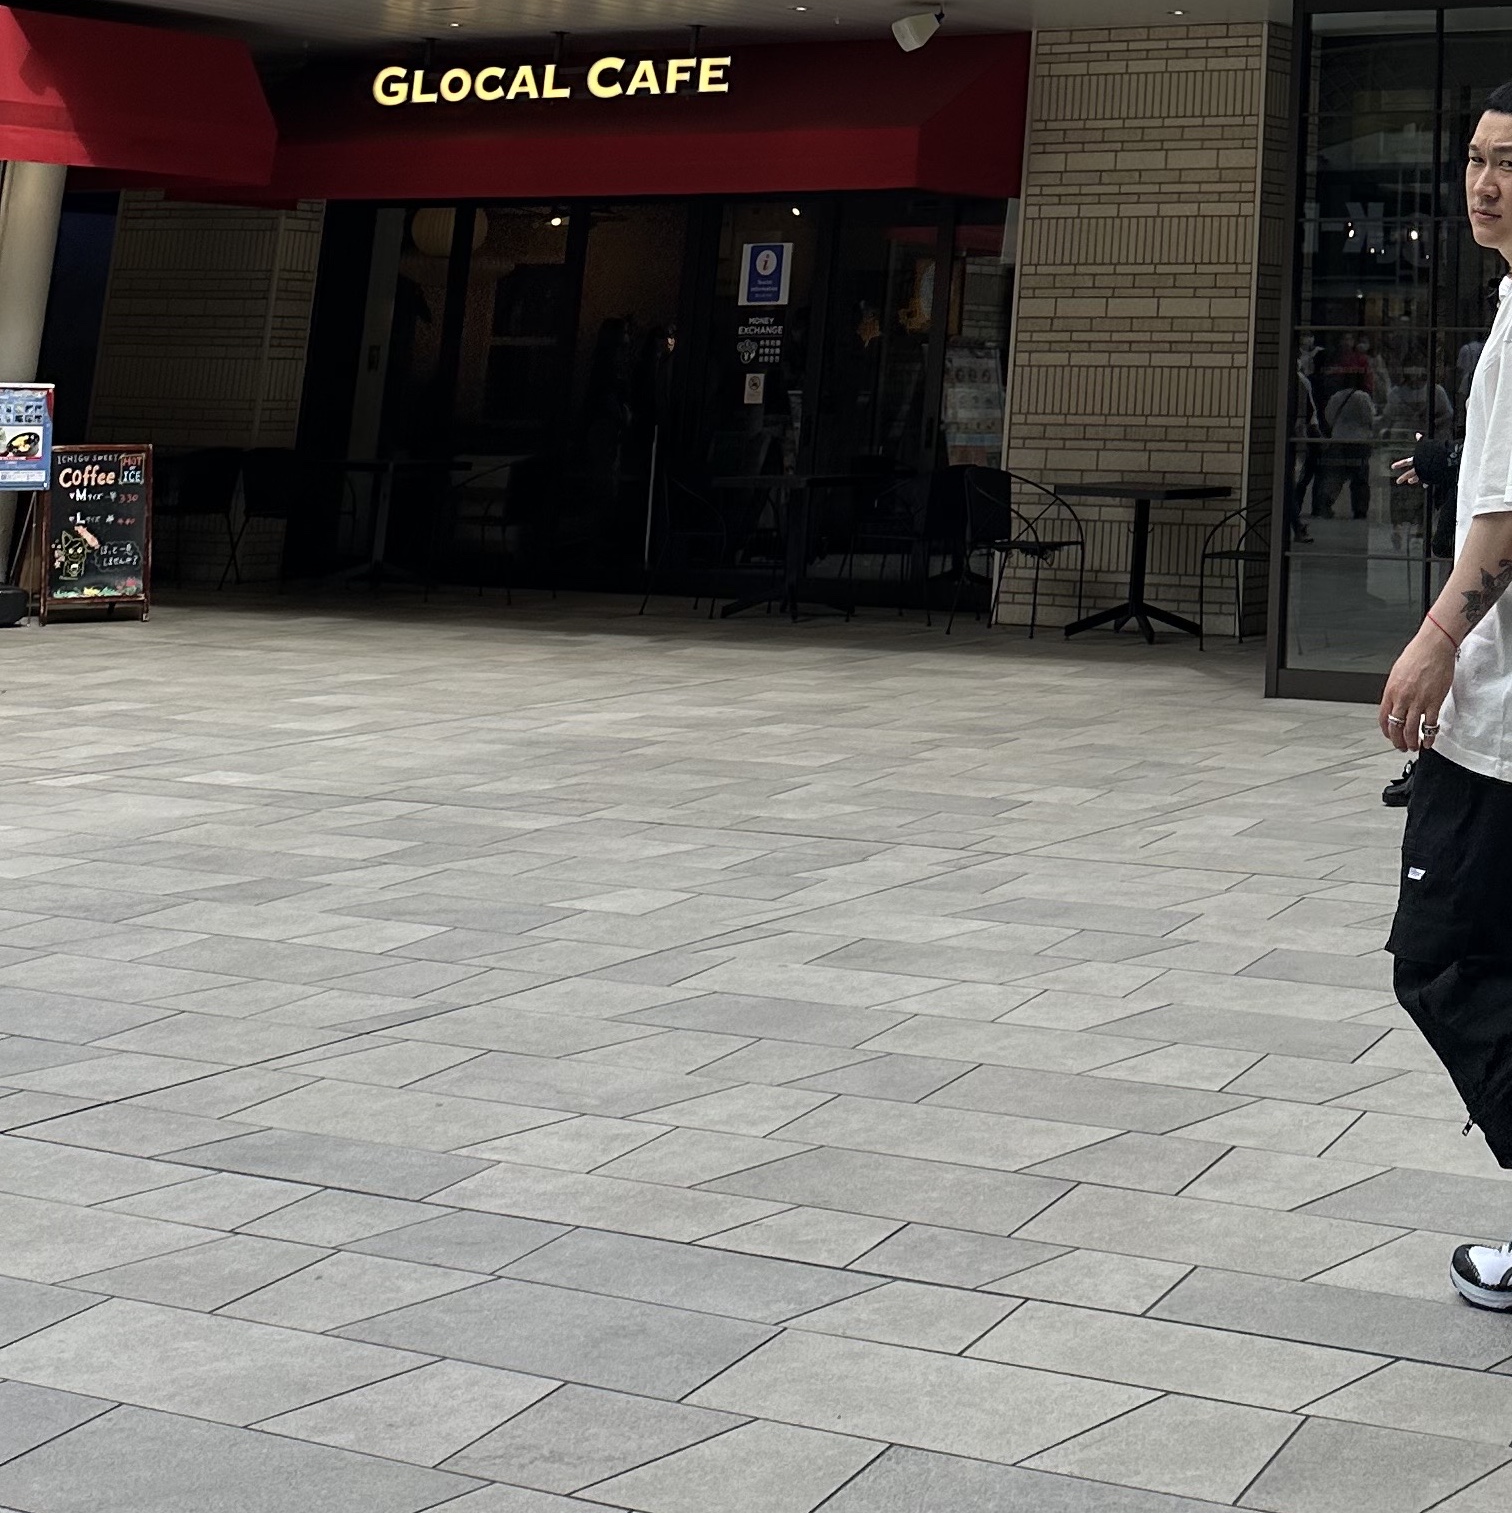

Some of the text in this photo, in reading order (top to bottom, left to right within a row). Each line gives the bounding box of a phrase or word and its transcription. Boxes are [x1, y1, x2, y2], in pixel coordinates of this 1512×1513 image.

[372, 56, 731, 106] GLOCAL CAFE
[748, 317, 775, 325] MONEY
[738, 325, 784, 335] EXCHANGE
[122, 456, 142, 466] HOT
[59, 464, 116, 488] Coffee
[123, 470, 142, 482] ICE
